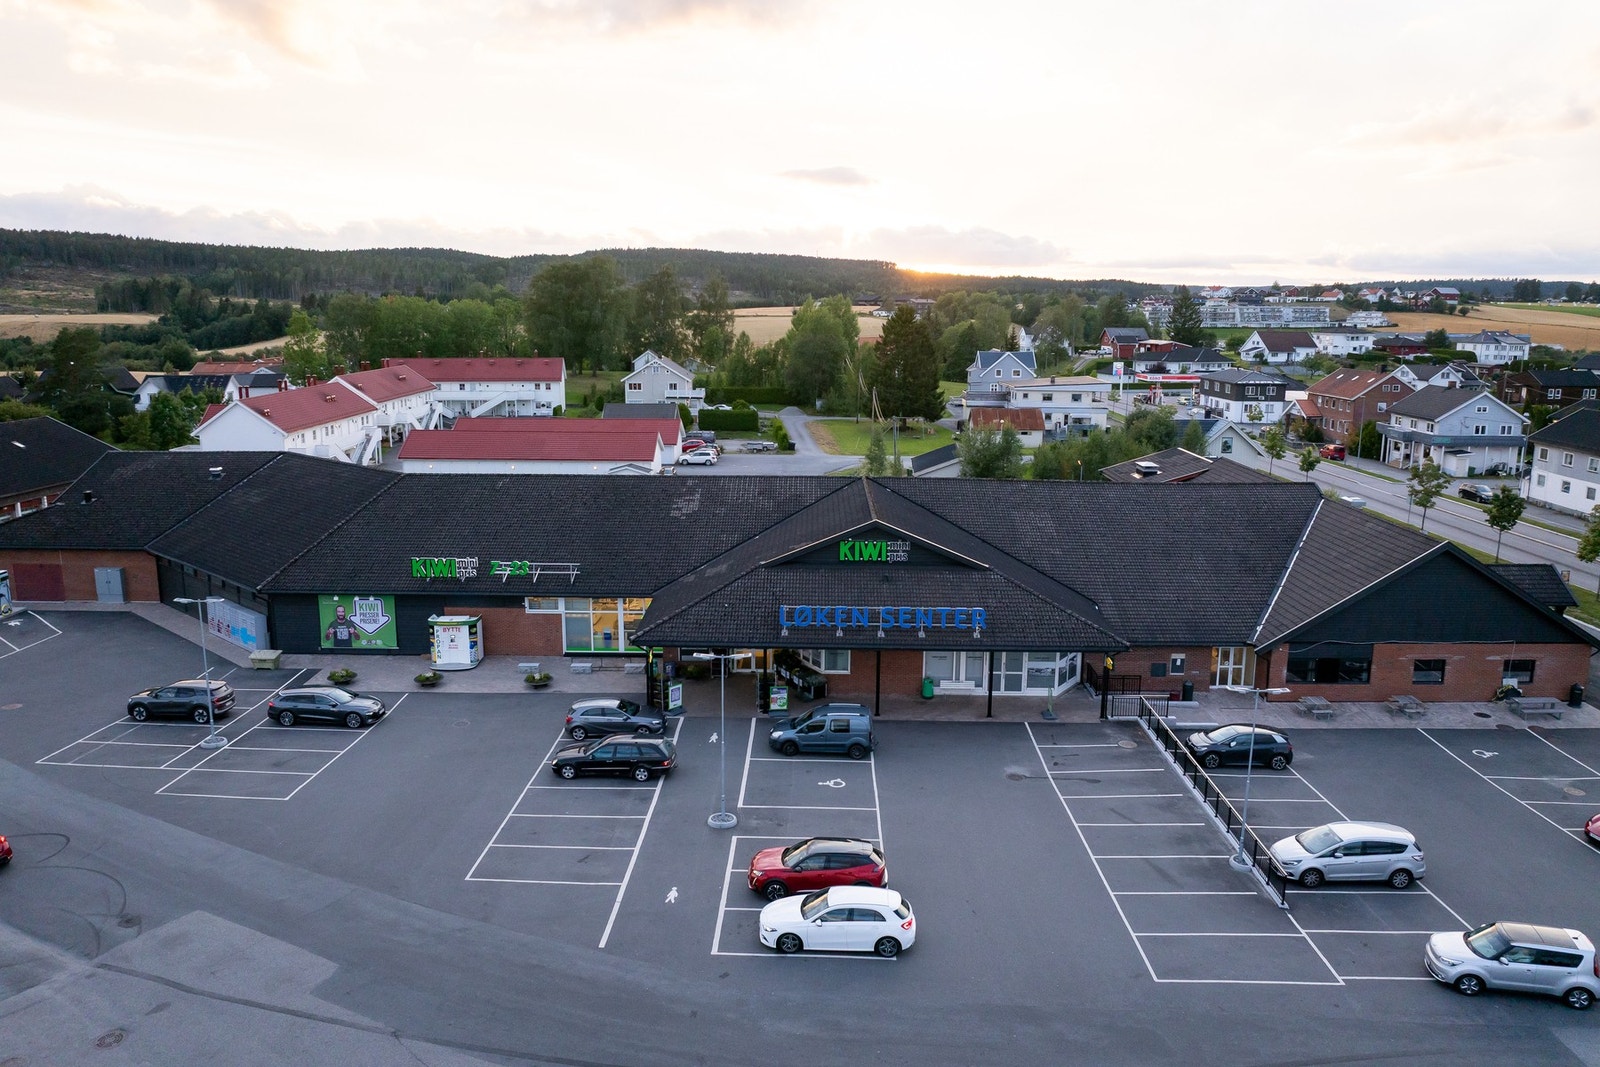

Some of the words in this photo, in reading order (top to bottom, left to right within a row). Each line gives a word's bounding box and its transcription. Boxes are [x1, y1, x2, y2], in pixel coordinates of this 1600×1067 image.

[839, 540, 886, 561] KIWI
[889, 540, 911, 550] mini
[458, 557, 479, 567] mini
[889, 550, 909, 563] pris
[411, 557, 457, 578] KIWI
[458, 567, 478, 580] pris
[358, 603, 380, 612] KIWI
[779, 605, 869, 628] LØKEN
[881, 607, 987, 630] SENTER
